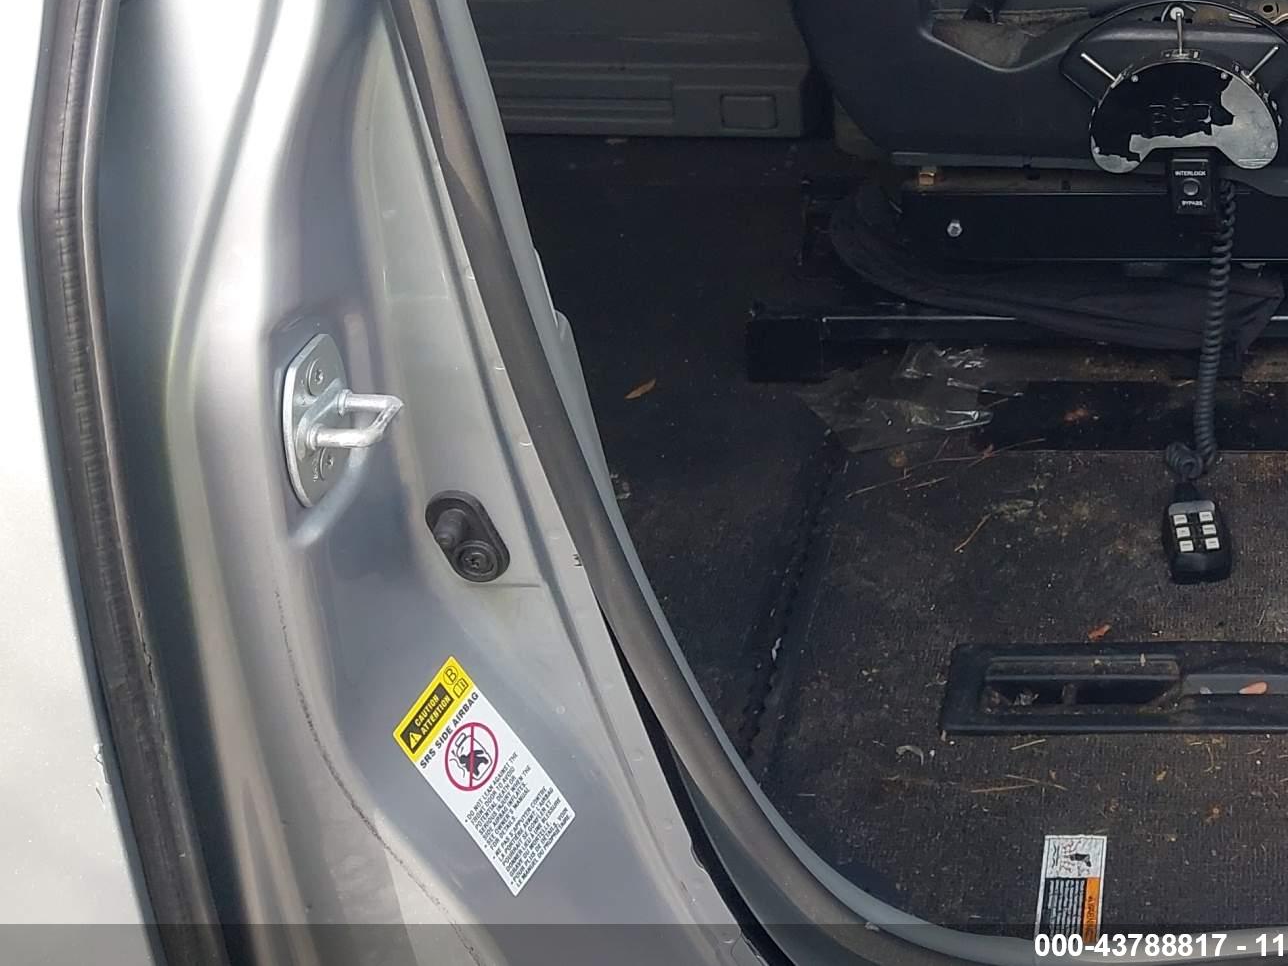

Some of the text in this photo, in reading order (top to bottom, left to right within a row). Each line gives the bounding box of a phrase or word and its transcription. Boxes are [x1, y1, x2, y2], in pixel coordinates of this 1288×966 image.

[444, 666, 457, 683] B
[414, 693, 439, 728] CAUTION
[419, 693, 451, 736] ATTENTION
[419, 689, 479, 770] SRS SIDE AIRBAG
[466, 750, 518, 821] DO NOT LEAN AGAINST THE
[470, 765, 515, 826] FRONT DOOR TO AVOID
[474, 774, 516, 831] POTENTIAL DEATH OR
[478, 764, 531, 836] SERIOUS INJURY WHEN THE
[482, 826, 493, 841] SIDE
[492, 805, 508, 827] AIRBAG
[486, 786, 530, 846] SEE OWNER'S MANUAL
[489, 837, 500, 851] FOR
